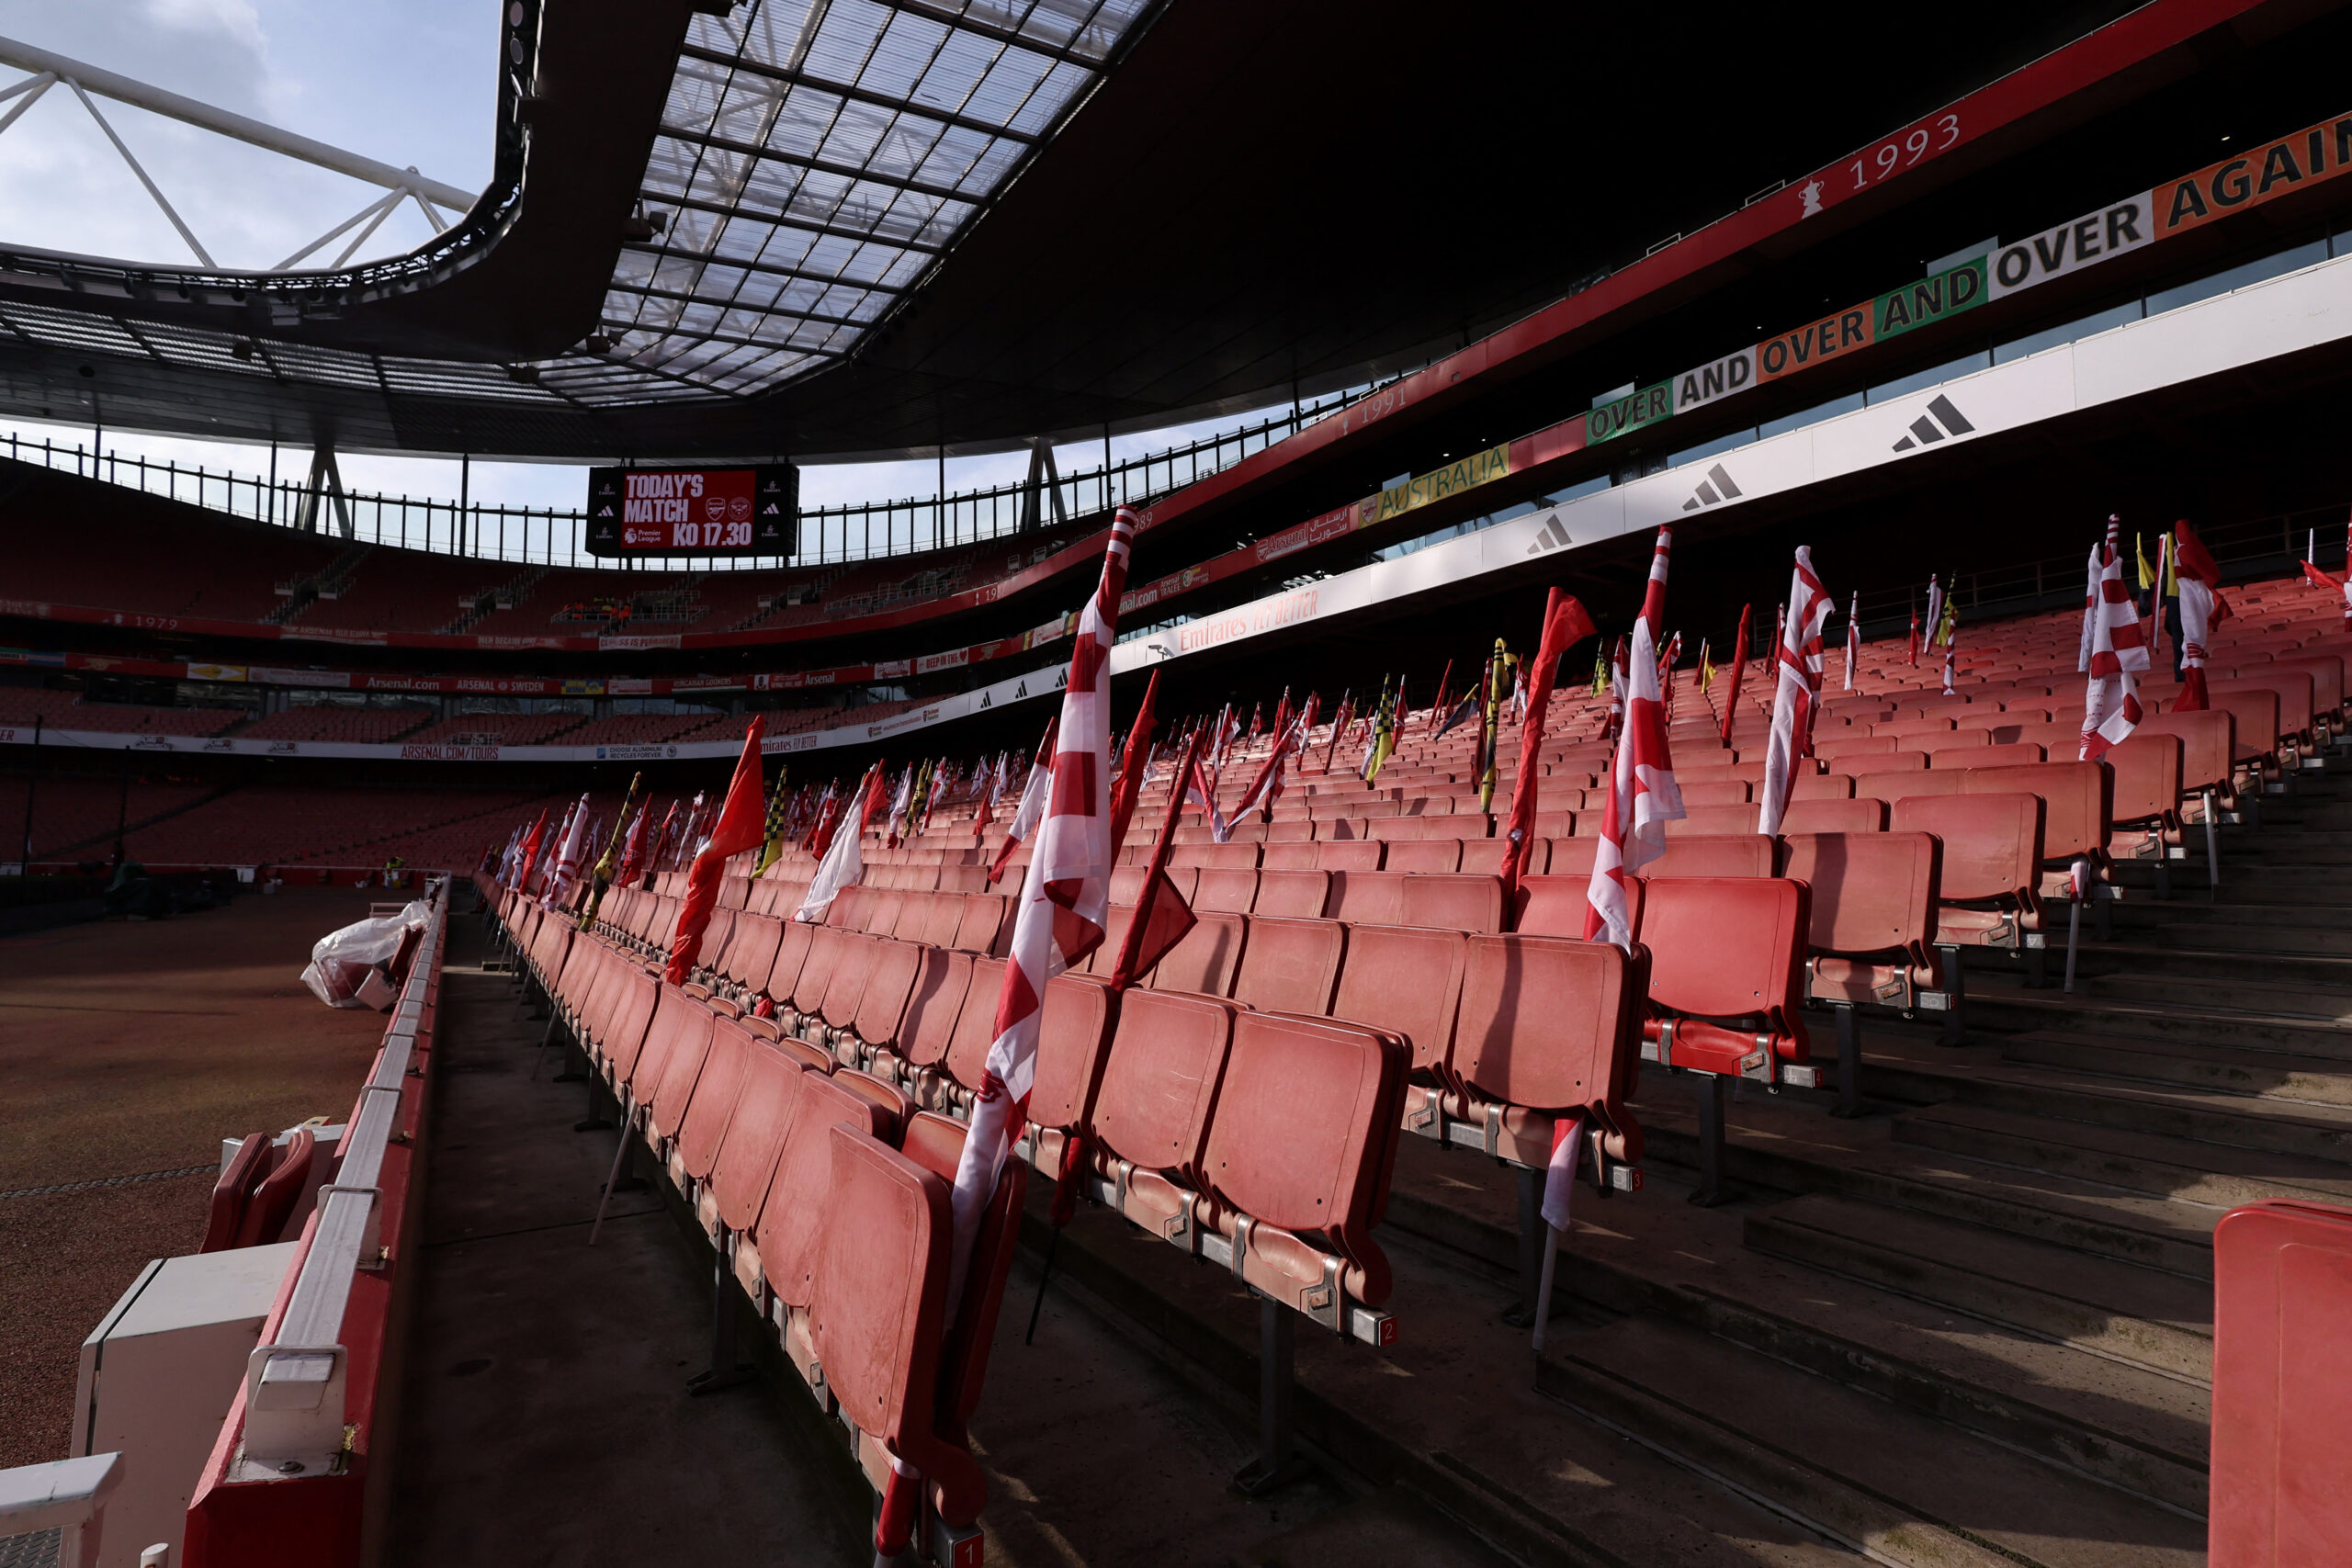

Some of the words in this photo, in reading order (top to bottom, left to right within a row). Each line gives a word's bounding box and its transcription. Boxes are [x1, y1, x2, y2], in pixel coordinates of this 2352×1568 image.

[1849, 113, 1961, 189] 1993
[1590, 386, 1668, 439] OVER
[1679, 355, 1750, 410] AND
[1762, 310, 1864, 375] OVER
[1881, 265, 1981, 334] AND
[1996, 202, 2143, 288] OVER
[1362, 387, 1406, 423] 1991
[627, 474, 704, 498] TODAY'S
[1380, 448, 1506, 518] AUSTRALIA
[625, 499, 689, 523] MATCH
[1134, 512, 1153, 535] 989
[673, 523, 698, 547] KO
[703, 522, 752, 546] 17.30
[1268, 523, 1309, 552] Arsenal
[1160, 574, 1180, 587] Arsenal
[985, 586, 1005, 601] 1987
[1160, 583, 1182, 596] TRALEE
[135, 616, 178, 629] 1979
[1181, 615, 1247, 651] Emirates
[1253, 604, 1272, 631] FLY
[1275, 590, 1318, 625] BETTER
[630, 638, 639, 647] IS
[926, 657, 940, 669] DEEP
[947, 653, 958, 664] THE
[368, 676, 440, 690] Arsenal.com
[457, 679, 494, 691] ARSENAL
[511, 681, 544, 692] SWEDEN
[805, 671, 835, 685] Arsenal
[761, 740, 792, 752] mirates
[801, 736, 817, 749] BETTER
[401, 745, 499, 761] ARSENAL.COM/TOURS
[1634, 1174, 1641, 1188] 3
[1385, 1323, 1393, 1340] 2
[965, 1543, 973, 1565] 1
